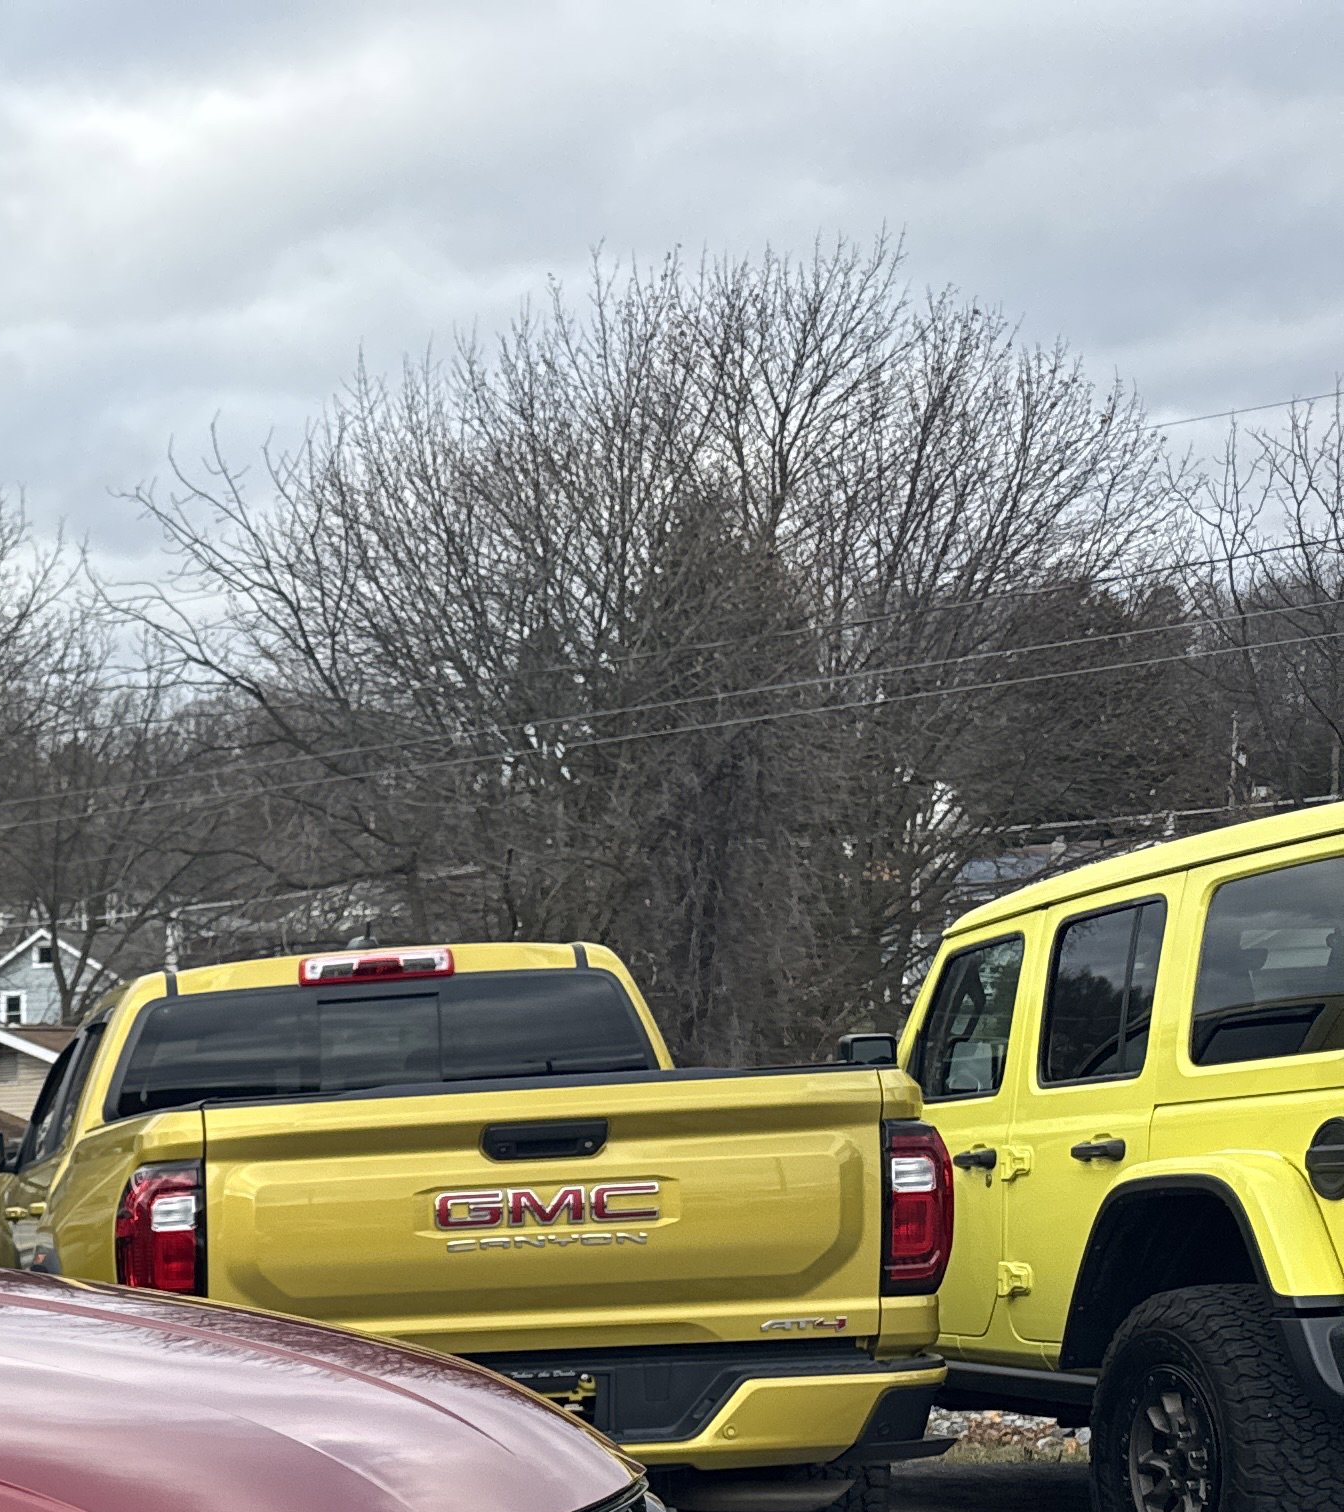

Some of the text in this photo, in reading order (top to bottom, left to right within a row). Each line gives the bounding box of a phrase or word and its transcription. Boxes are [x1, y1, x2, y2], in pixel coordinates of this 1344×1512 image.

[434, 1181, 660, 1231] GMC
[447, 1232, 648, 1253] CANYON
[760, 1315, 848, 1333] AT4
